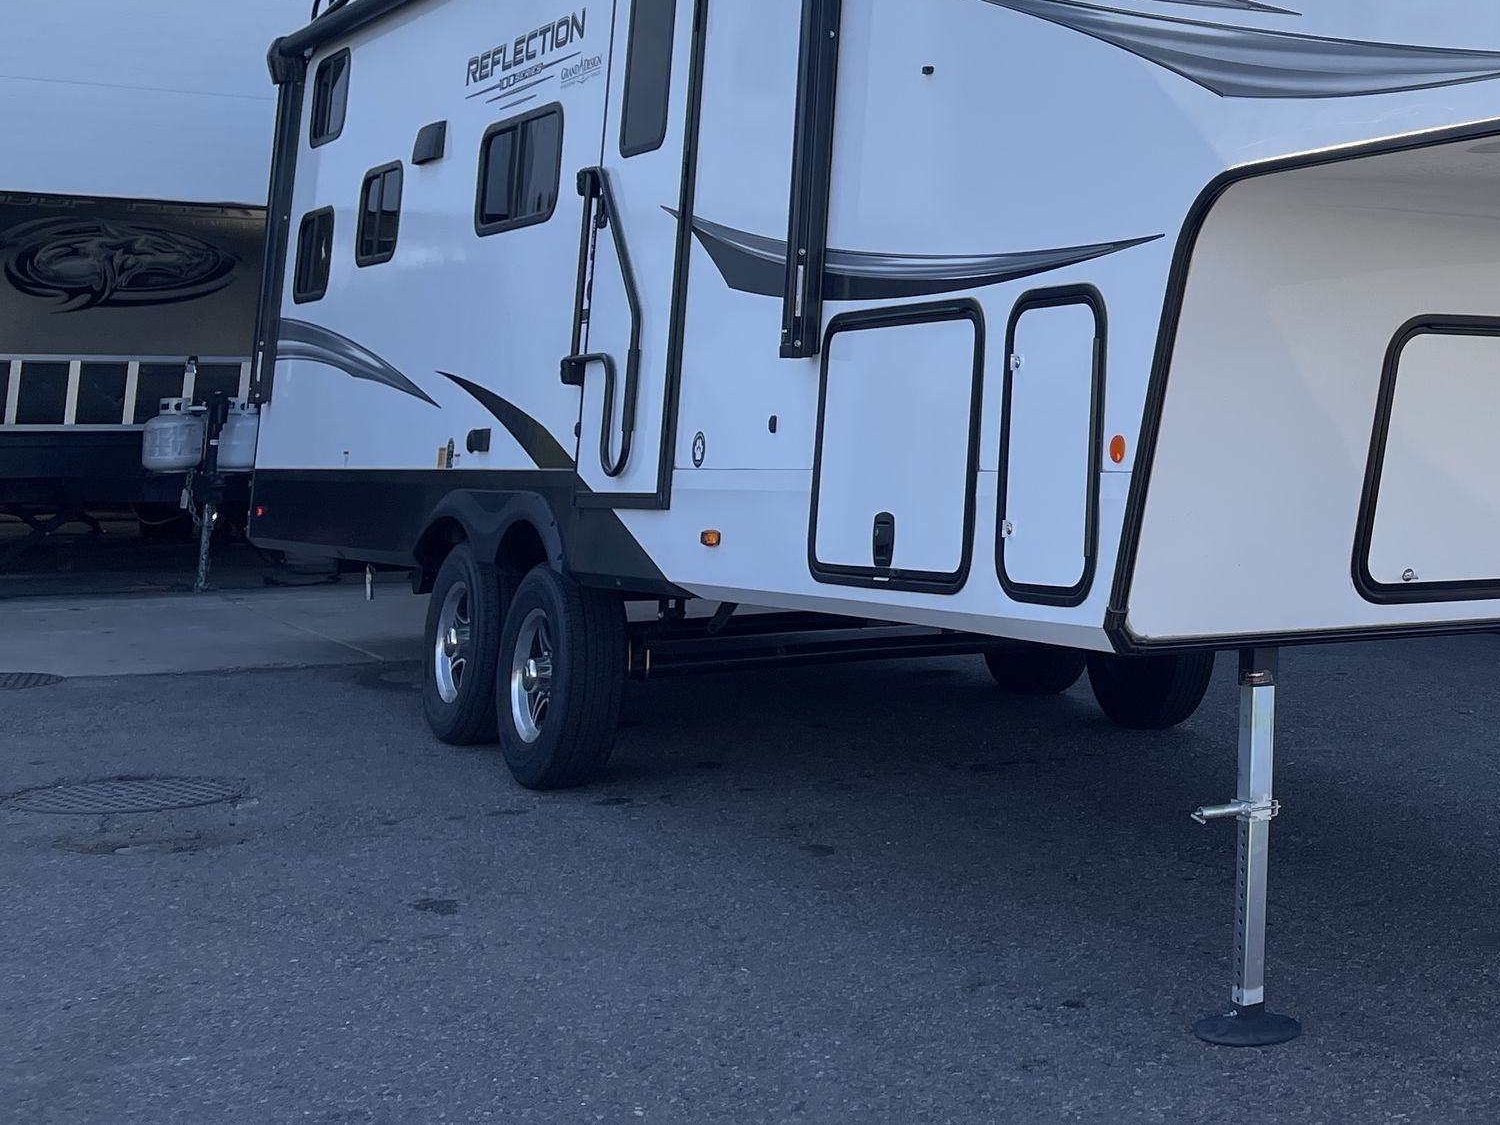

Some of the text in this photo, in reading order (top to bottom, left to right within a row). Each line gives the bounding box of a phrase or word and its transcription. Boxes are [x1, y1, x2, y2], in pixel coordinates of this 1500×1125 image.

[465, 7, 587, 87] REFLECTION
[498, 73, 516, 92] 100
[514, 62, 544, 83] SERIES
[560, 64, 581, 81] GRAND
[583, 54, 603, 71] DESIGN
